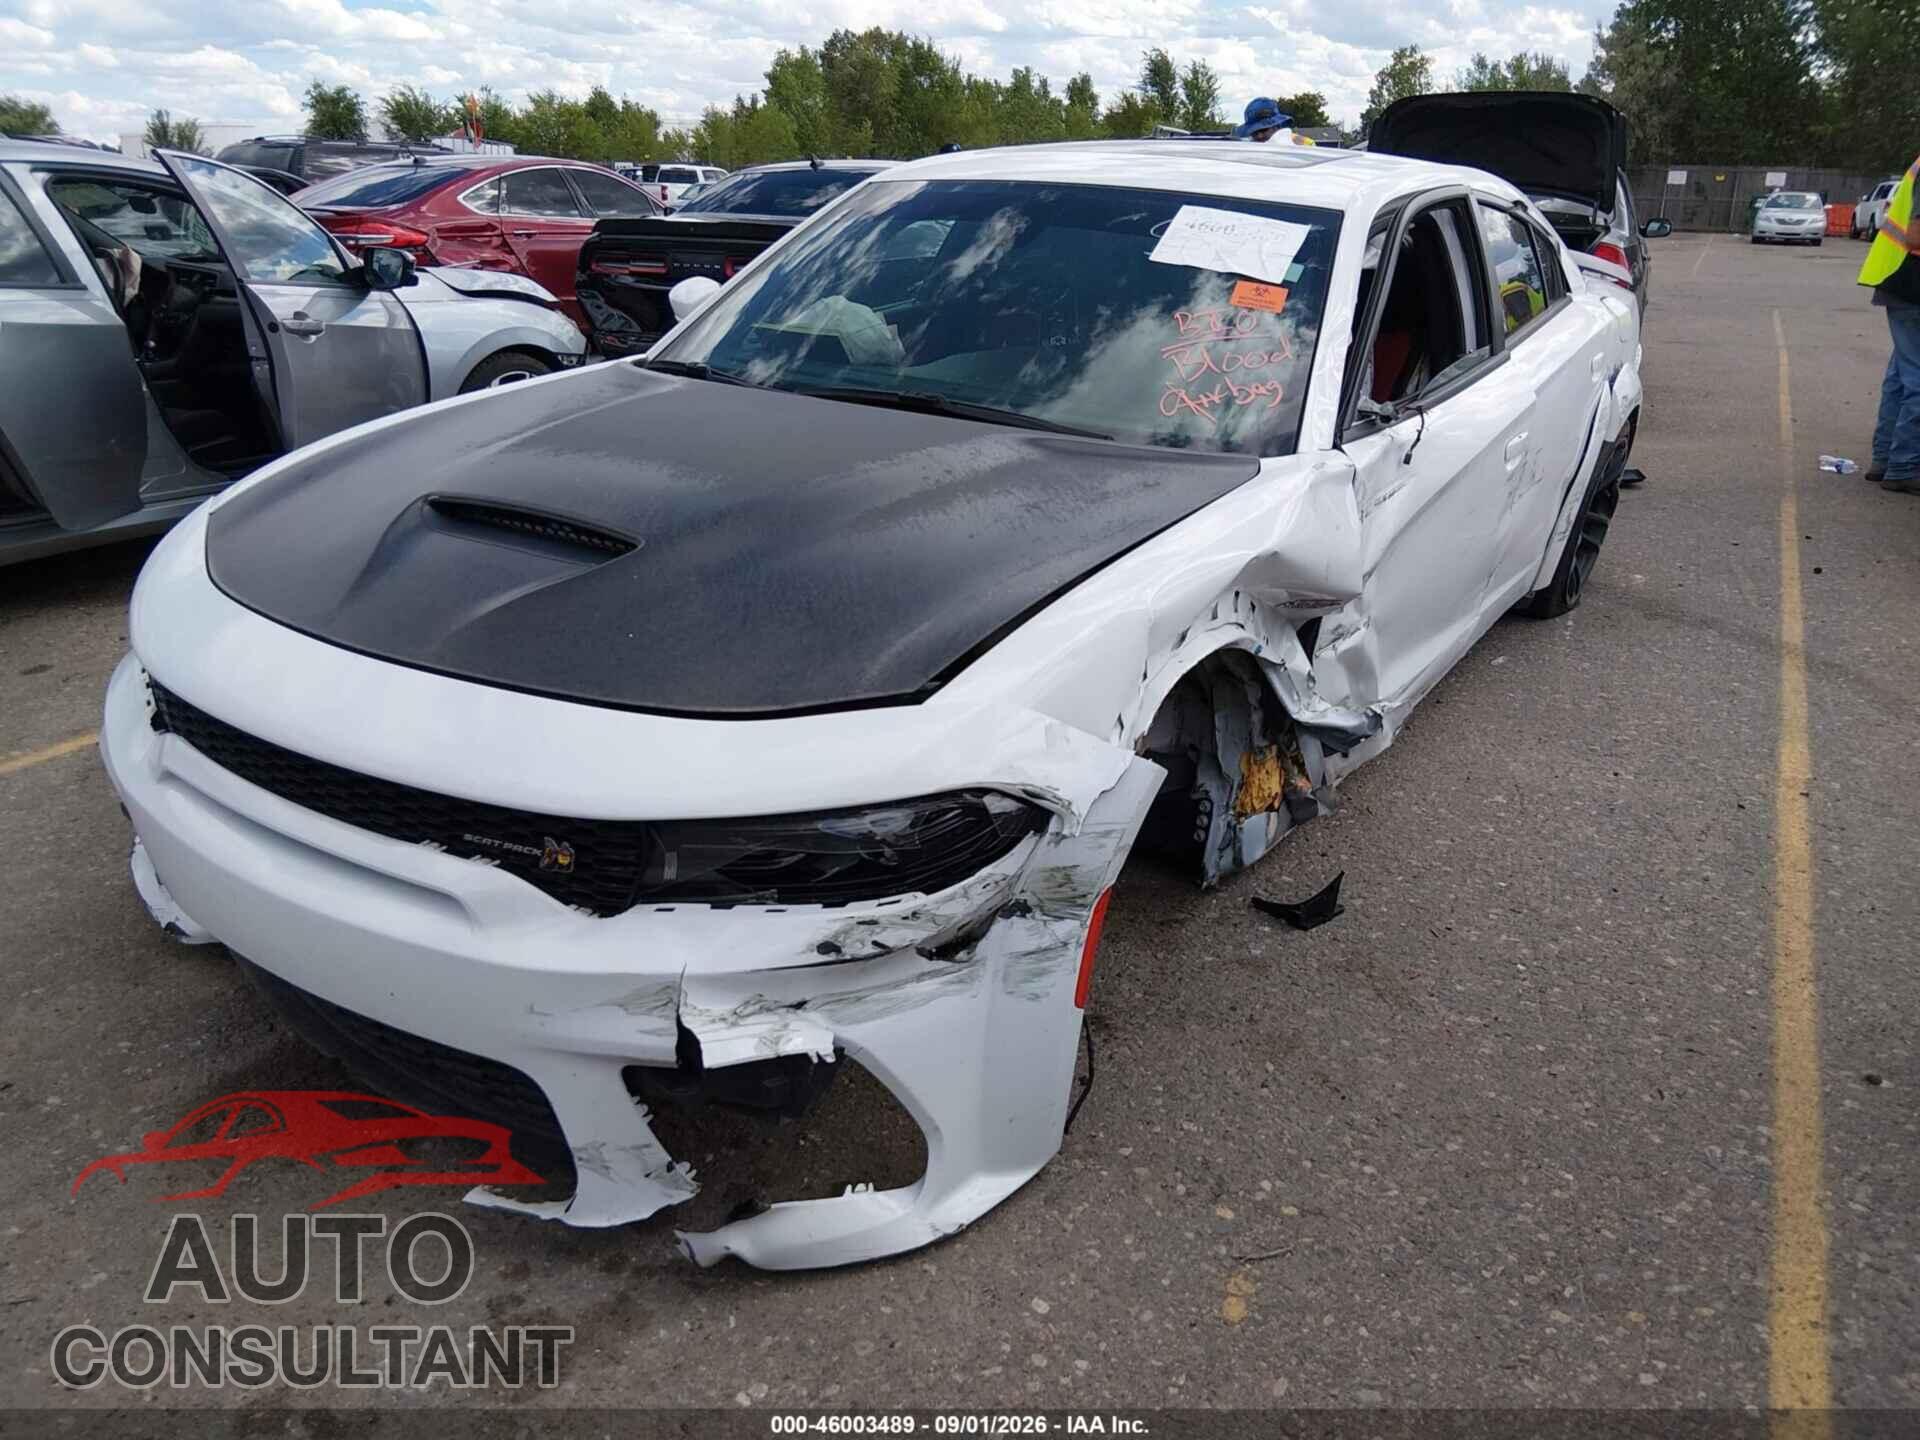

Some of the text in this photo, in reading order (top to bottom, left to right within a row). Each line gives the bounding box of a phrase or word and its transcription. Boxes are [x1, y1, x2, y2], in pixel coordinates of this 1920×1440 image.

[1174, 310, 1257, 337] BIO
[463, 833, 543, 857] SCAT PACK
